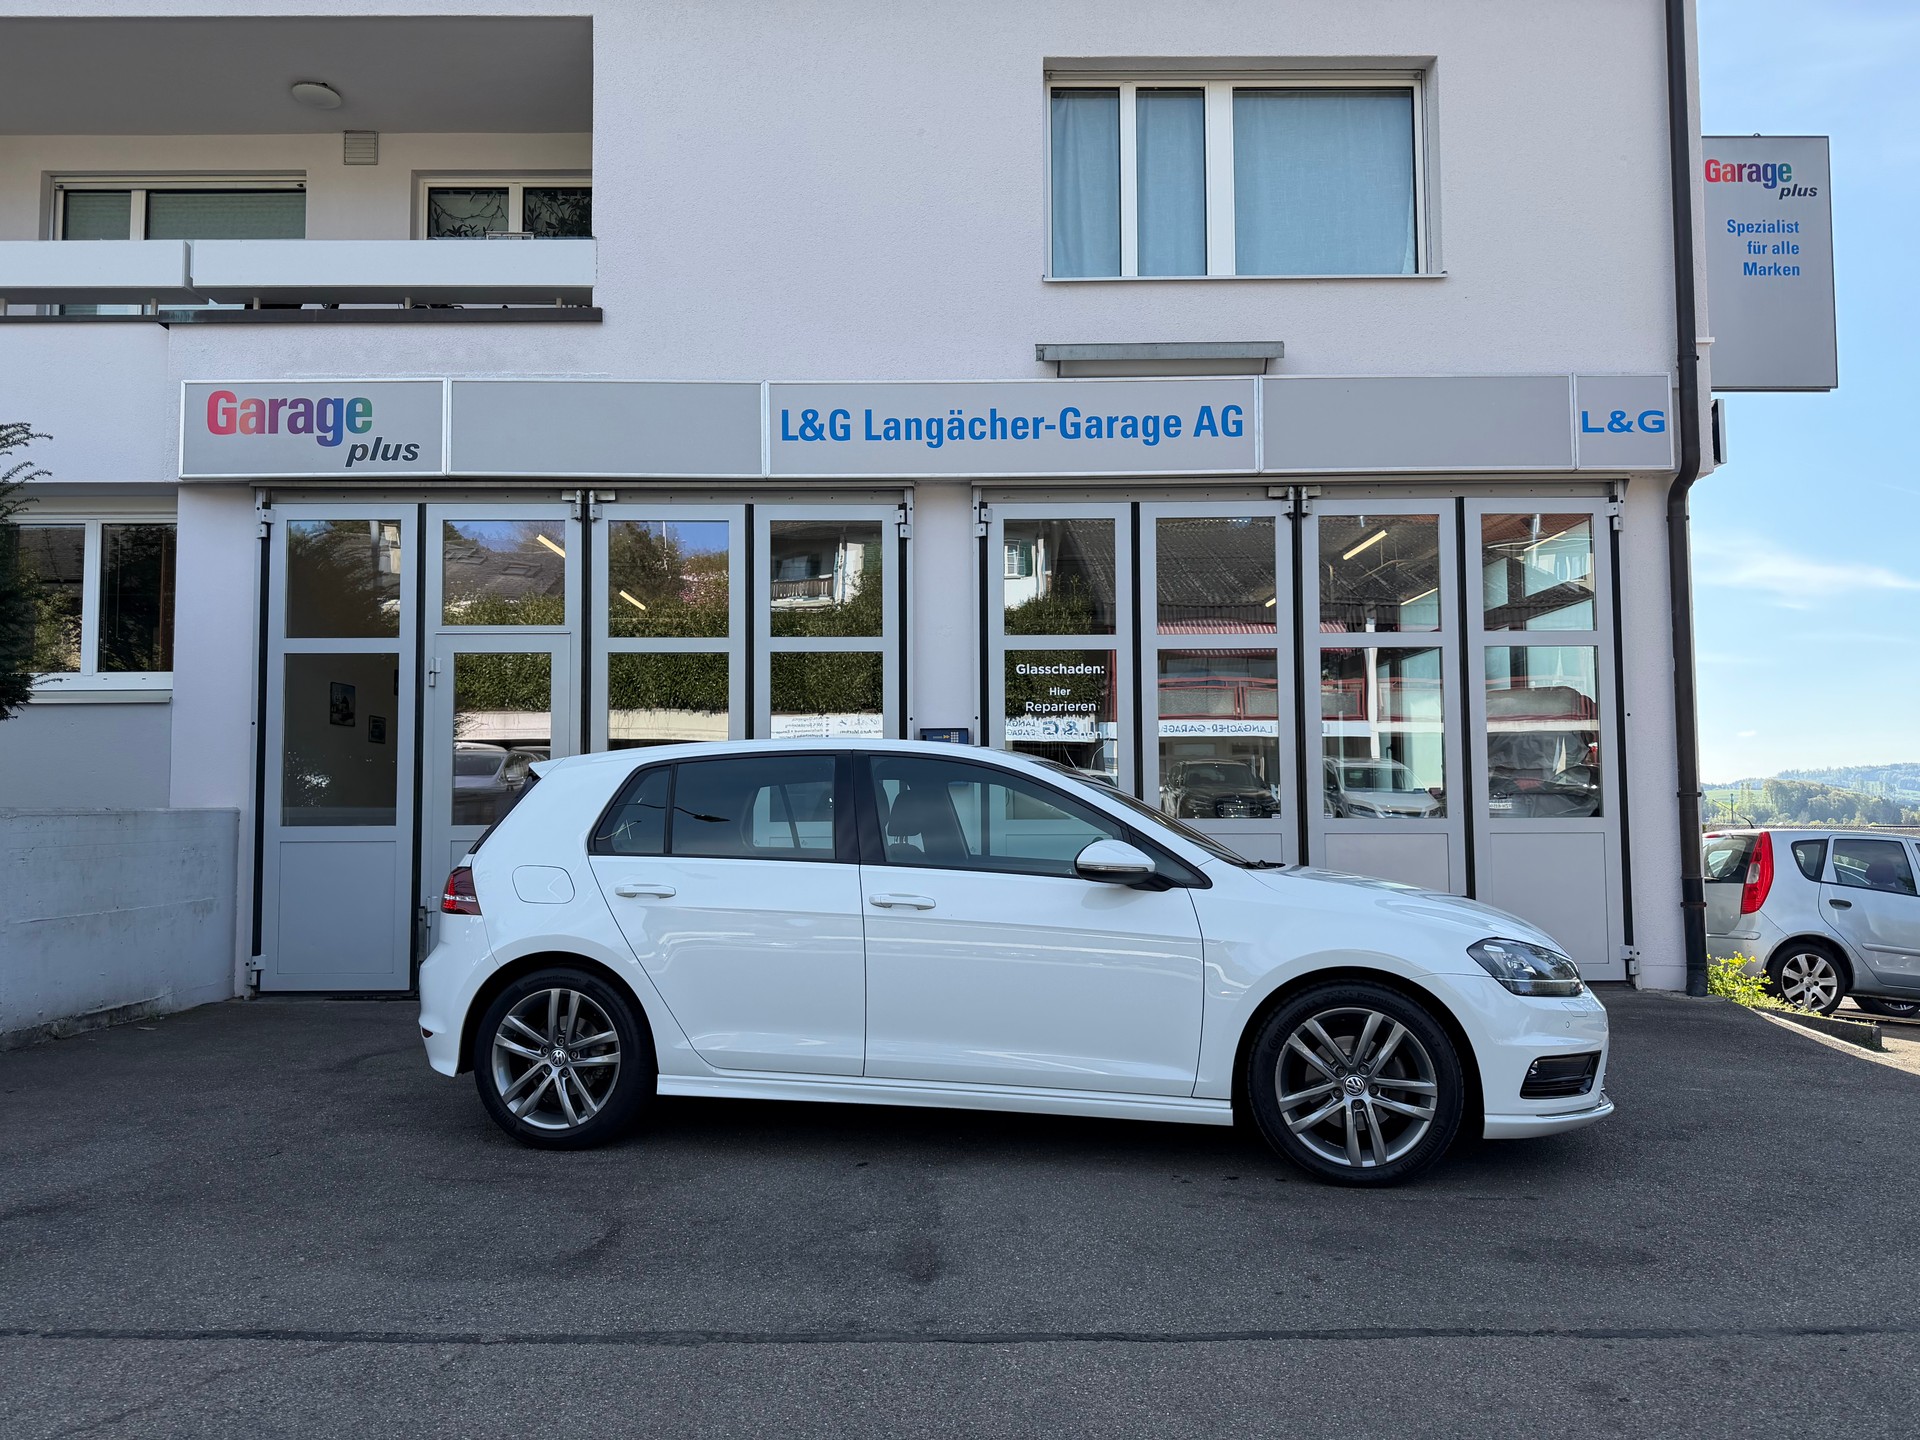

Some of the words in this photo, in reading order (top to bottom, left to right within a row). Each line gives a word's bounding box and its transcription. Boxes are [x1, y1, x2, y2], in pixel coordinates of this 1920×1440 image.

[1705, 159, 1793, 189] Garage
[1779, 184, 1818, 200] plus
[1727, 219, 1800, 237] Spezialist
[1747, 241, 1768, 255] für
[1772, 241, 1800, 255] alle
[1743, 262, 1800, 276] Marken
[207, 390, 373, 447] Garage
[780, 408, 851, 442] L&G
[864, 406, 1182, 448] Langächer-Garage
[1193, 404, 1244, 438] AG
[1582, 410, 1665, 433] L&G
[345, 436, 420, 468] plus
[1016, 663, 1105, 675] Glasschaden:
[1049, 687, 1071, 696] Hier
[1025, 701, 1096, 713] Reparieren
